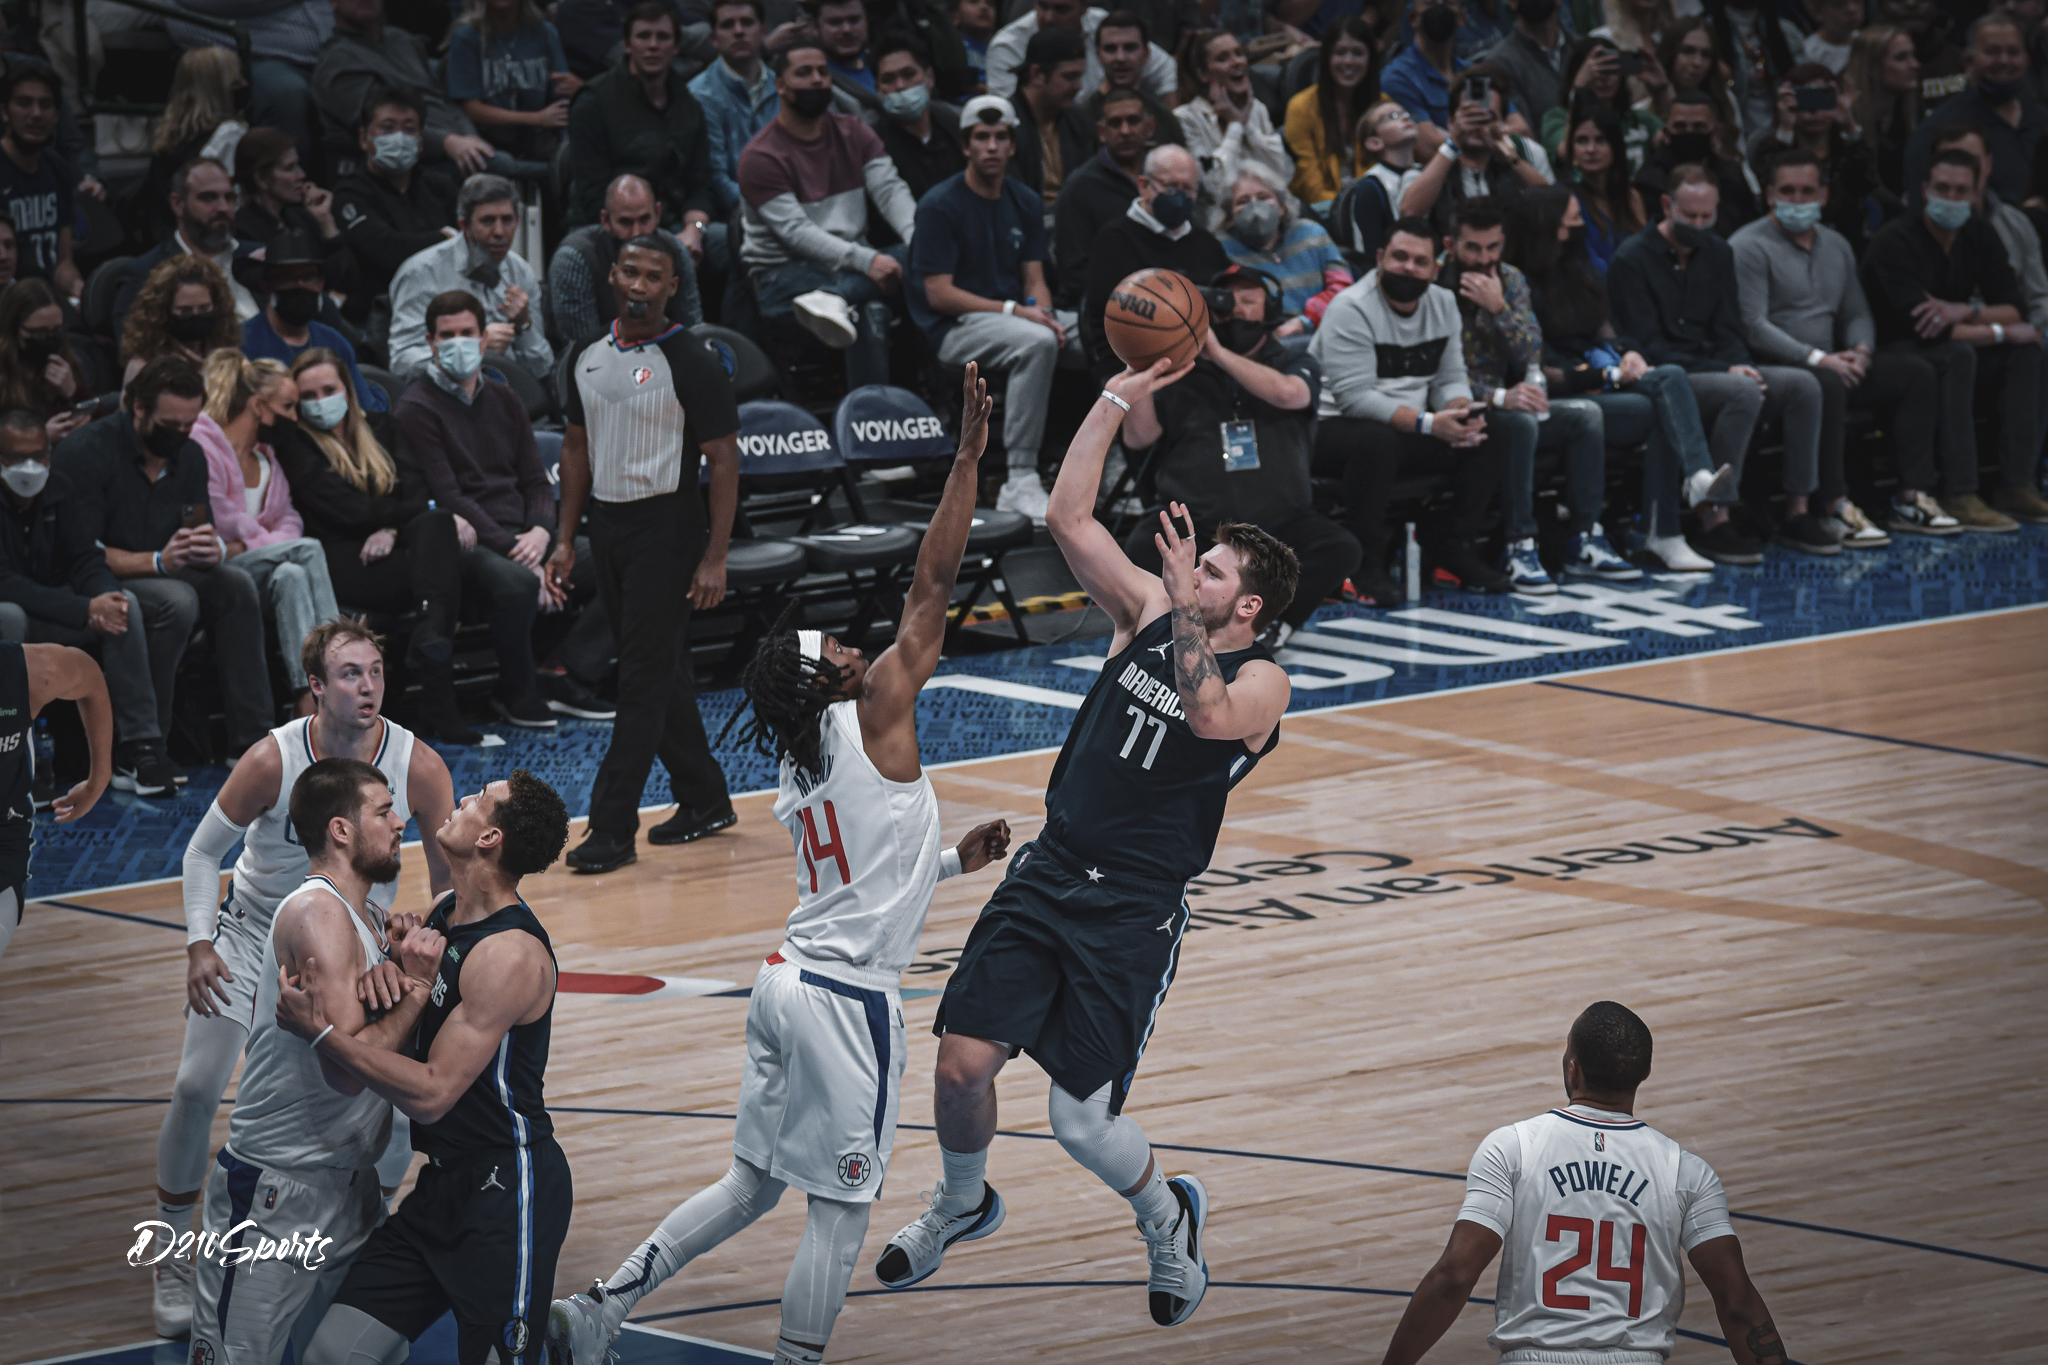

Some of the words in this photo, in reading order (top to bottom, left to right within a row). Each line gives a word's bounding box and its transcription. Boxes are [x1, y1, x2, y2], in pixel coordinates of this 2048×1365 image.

[736, 428, 831, 457] VOYAGER
[851, 415, 944, 443] VOYAGER
[1117, 661, 1187, 722] MAVERIC
[1119, 704, 1168, 771] 77
[795, 800, 851, 894] 14
[1295, 817, 1842, 905] American
[1548, 1160, 1650, 1207] POWELL
[1542, 1213, 1647, 1319] 24
